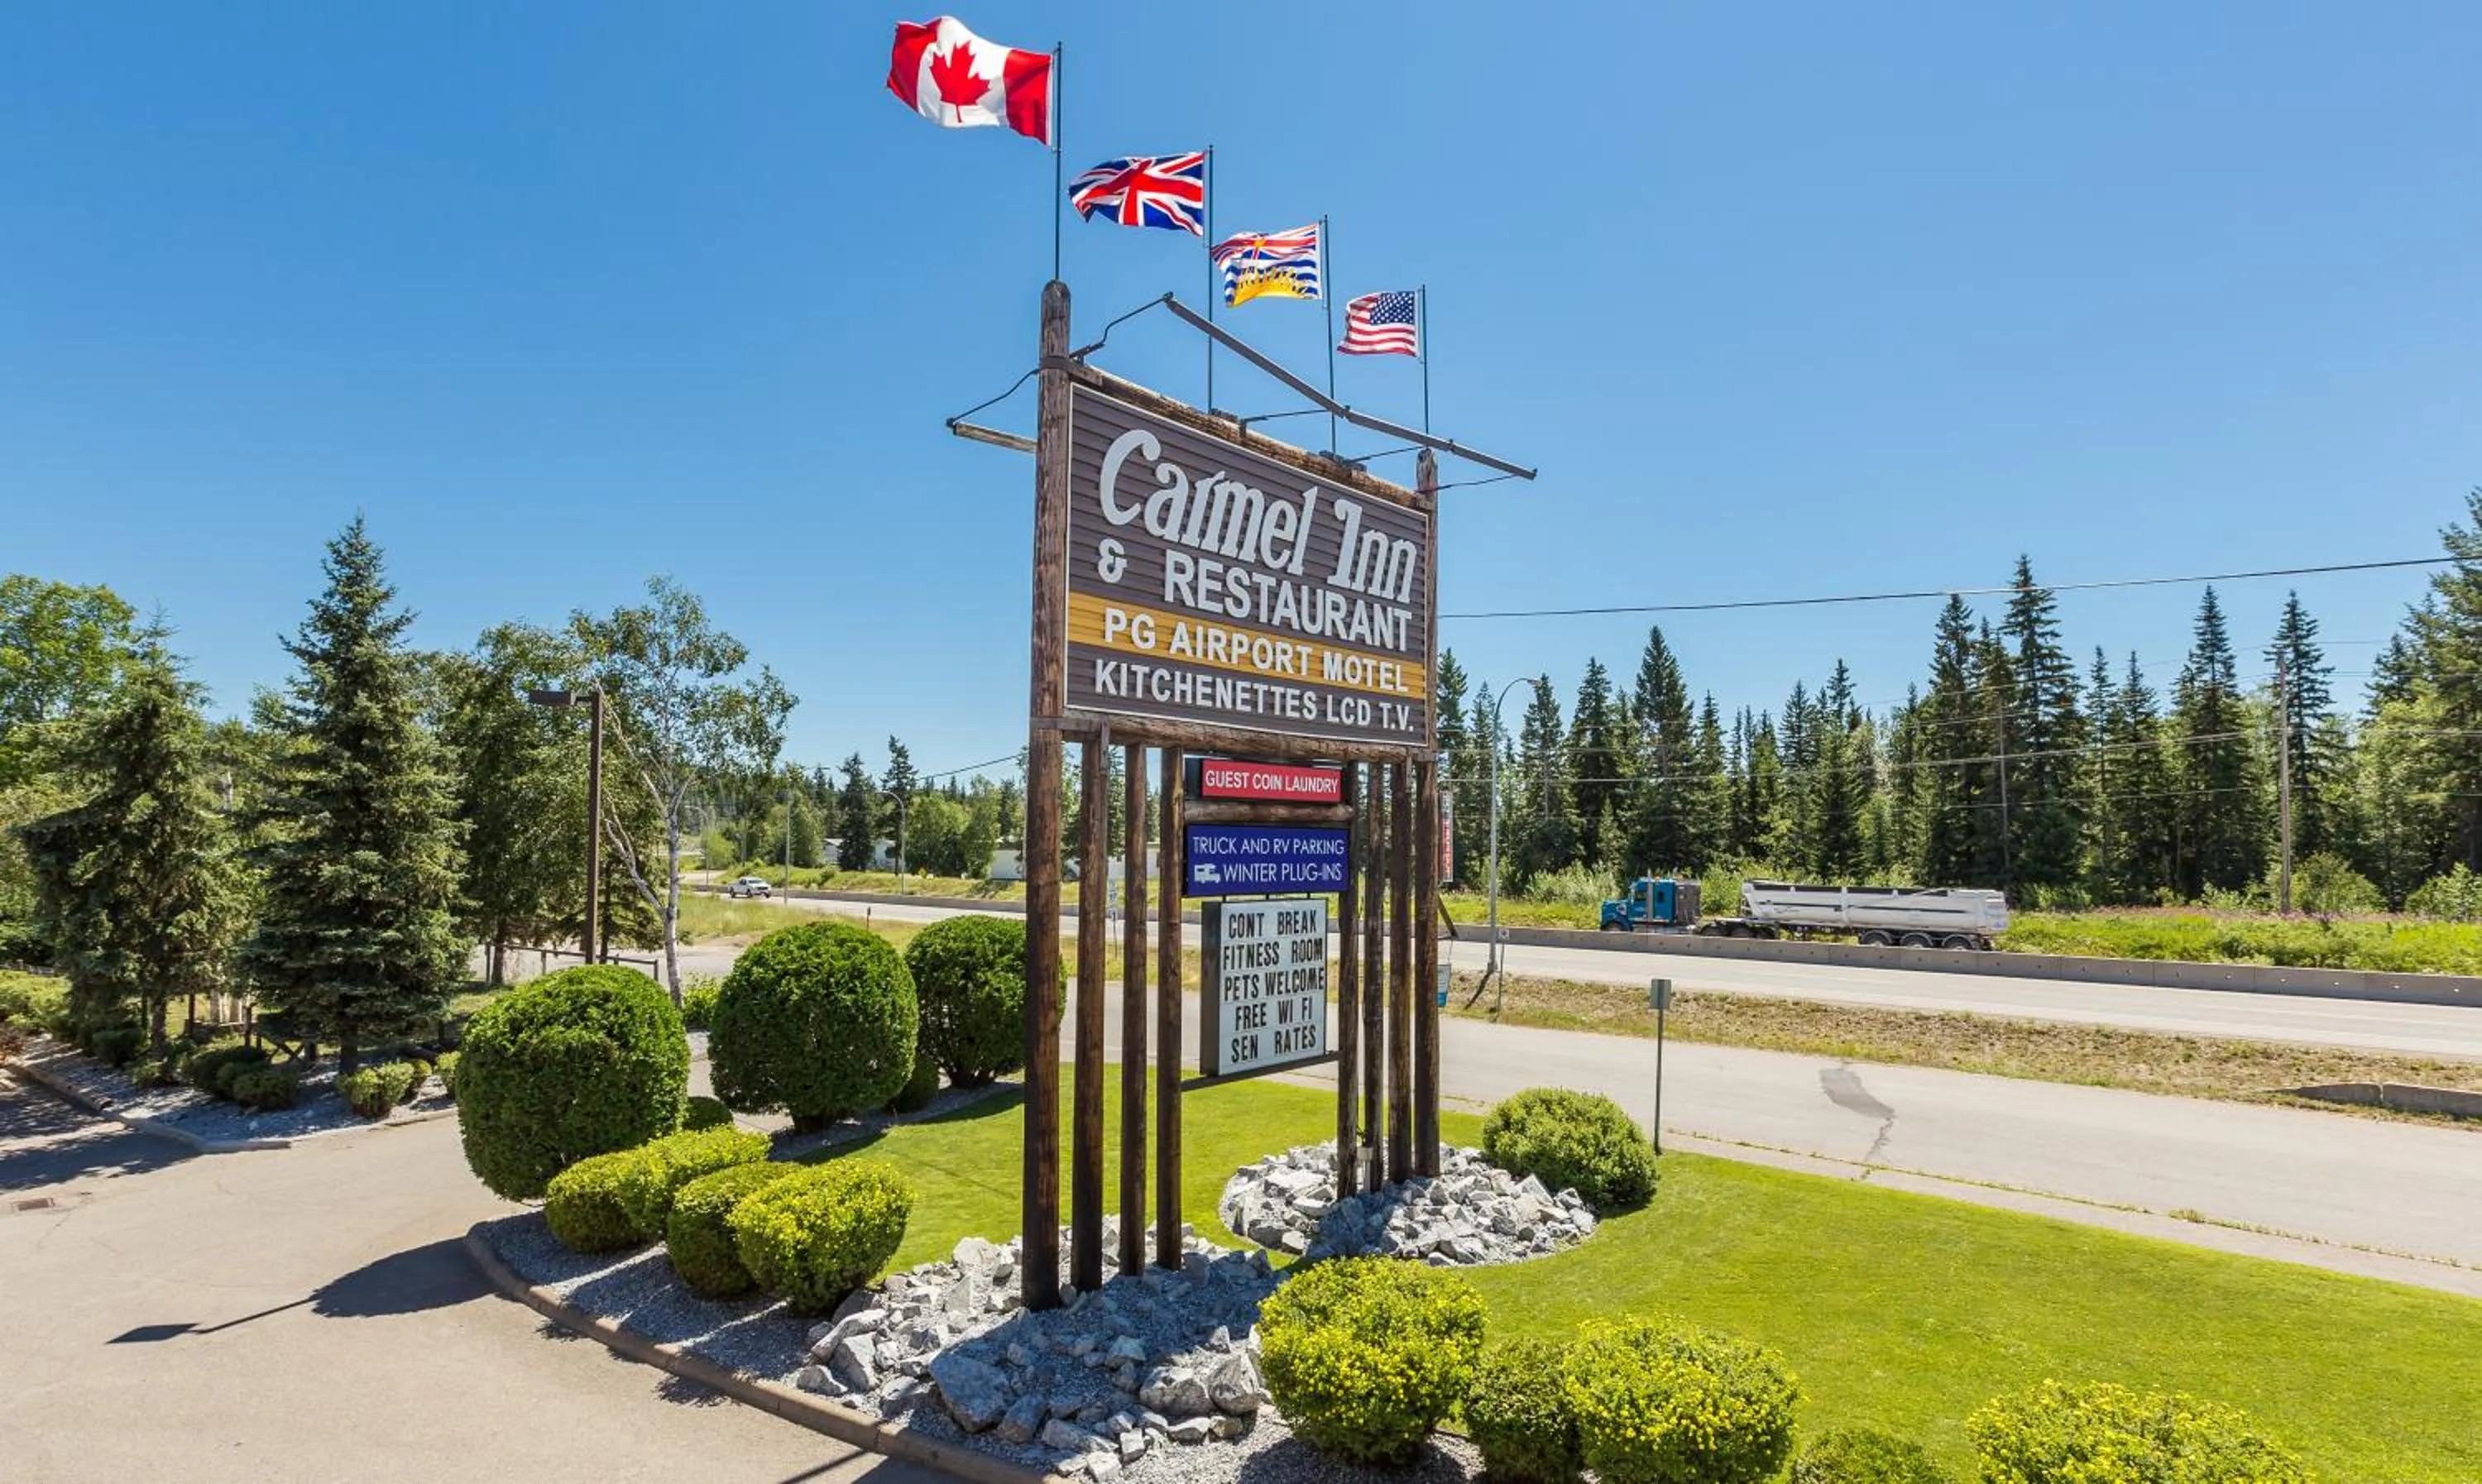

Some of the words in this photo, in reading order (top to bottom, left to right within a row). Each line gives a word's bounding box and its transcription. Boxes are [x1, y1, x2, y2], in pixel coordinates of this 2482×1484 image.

[1099, 429, 1318, 575] Carmel
[1328, 499, 1417, 604] Inn
[1097, 539, 1128, 582] &
[1164, 549, 1412, 652] RESTAURANT
[1104, 608, 1155, 649] PG
[1170, 622, 1312, 676] AIRPORT
[1324, 651, 1408, 692] MOTEL
[1095, 659, 1317, 720] KITCHENETTES
[1326, 694, 1370, 727] LCD
[1378, 702, 1414, 731] T.V.
[1205, 770, 1249, 788] GUEST
[1252, 773, 1282, 790] COIN
[1285, 777, 1339, 793] LAUNDRY
[1192, 836, 1237, 854] TRUCK
[1240, 838, 1270, 854] AND
[1273, 839, 1290, 854] RV
[1293, 840, 1344, 854] PARKING
[1223, 864, 1276, 882] WINTER
[1282, 863, 1342, 881] PLUG-INS
[1229, 912, 1264, 939] CONT
[1277, 910, 1317, 936] BREAK
[1223, 941, 1280, 970] FITNESS
[1291, 937, 1323, 964] ROOM
[1224, 974, 1259, 1002] PETS
[1265, 968, 1324, 997] WELCOME
[1235, 1003, 1267, 1031] FREE
[1277, 999, 1293, 1024] WI
[1301, 997, 1312, 1020] FI
[1231, 1034, 1258, 1063] SEN
[1275, 1025, 1316, 1055] RATES
